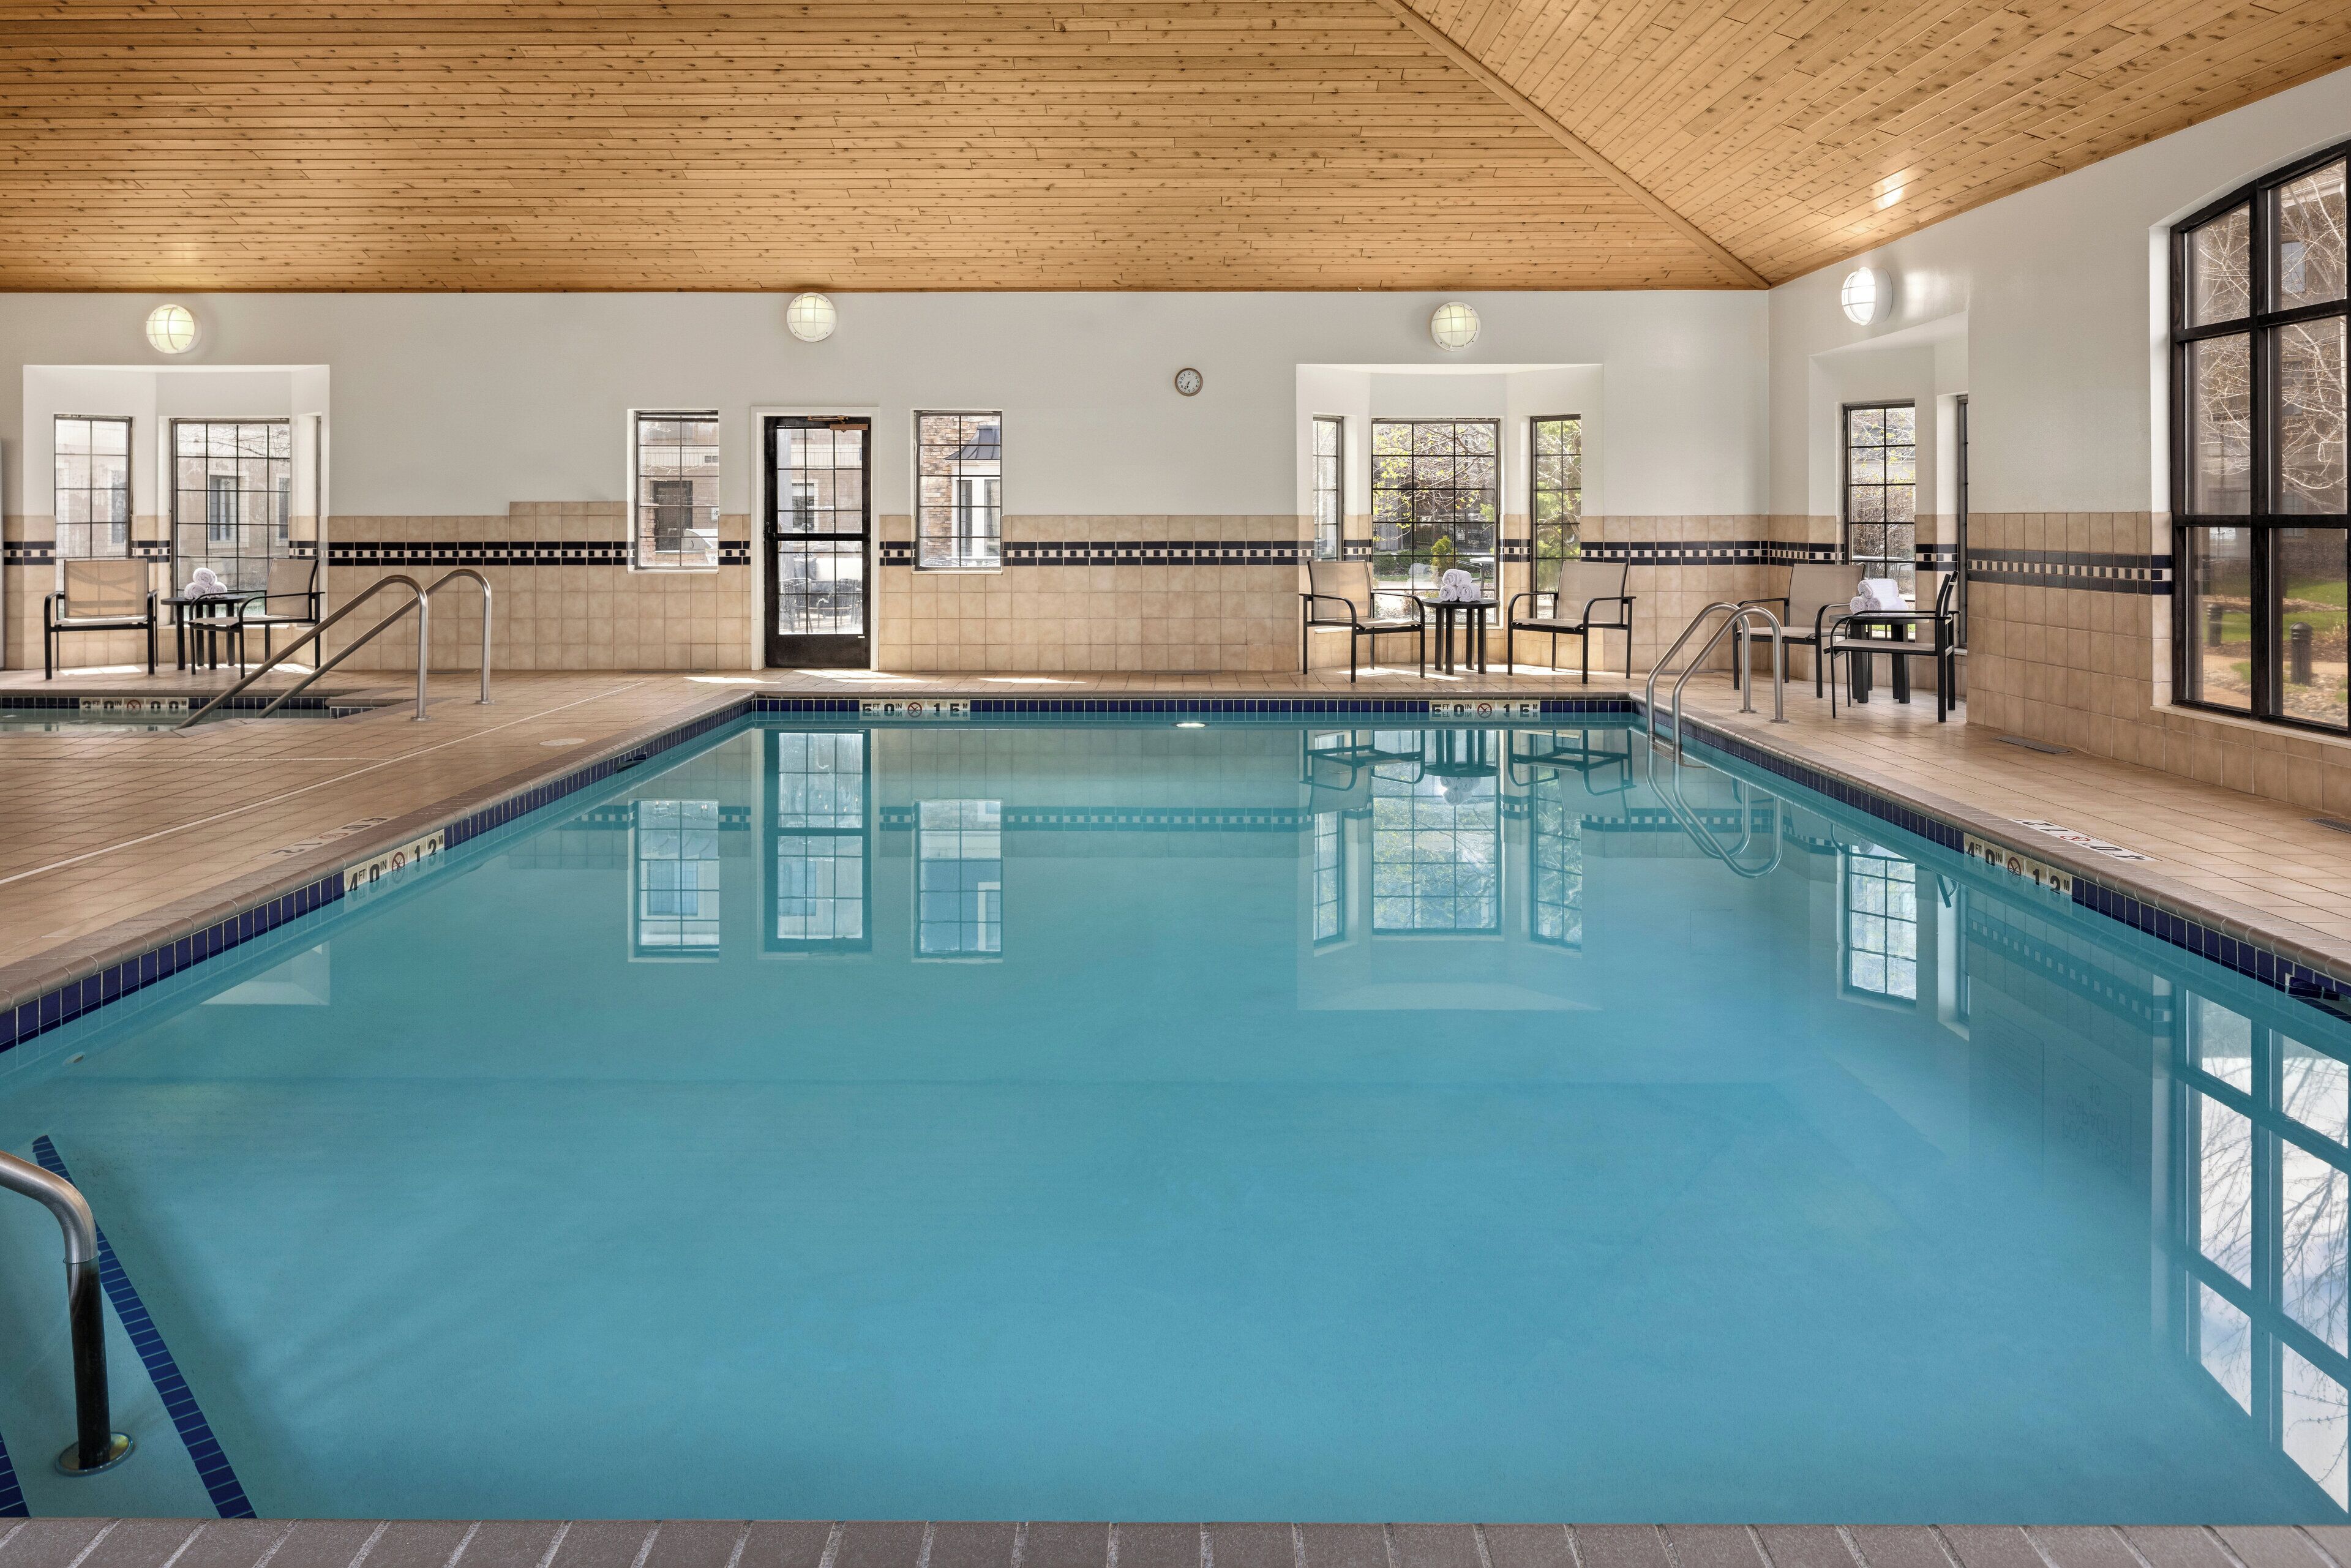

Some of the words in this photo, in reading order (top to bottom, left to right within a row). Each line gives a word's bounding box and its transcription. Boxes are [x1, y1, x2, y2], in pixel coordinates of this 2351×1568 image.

[358, 868, 366, 881] FT
[380, 859, 387, 871] IN
[438, 835, 444, 845] M
[1975, 843, 1982, 855] FT
[1995, 851, 2002, 864] IN
[2063, 879, 2070, 891] M
